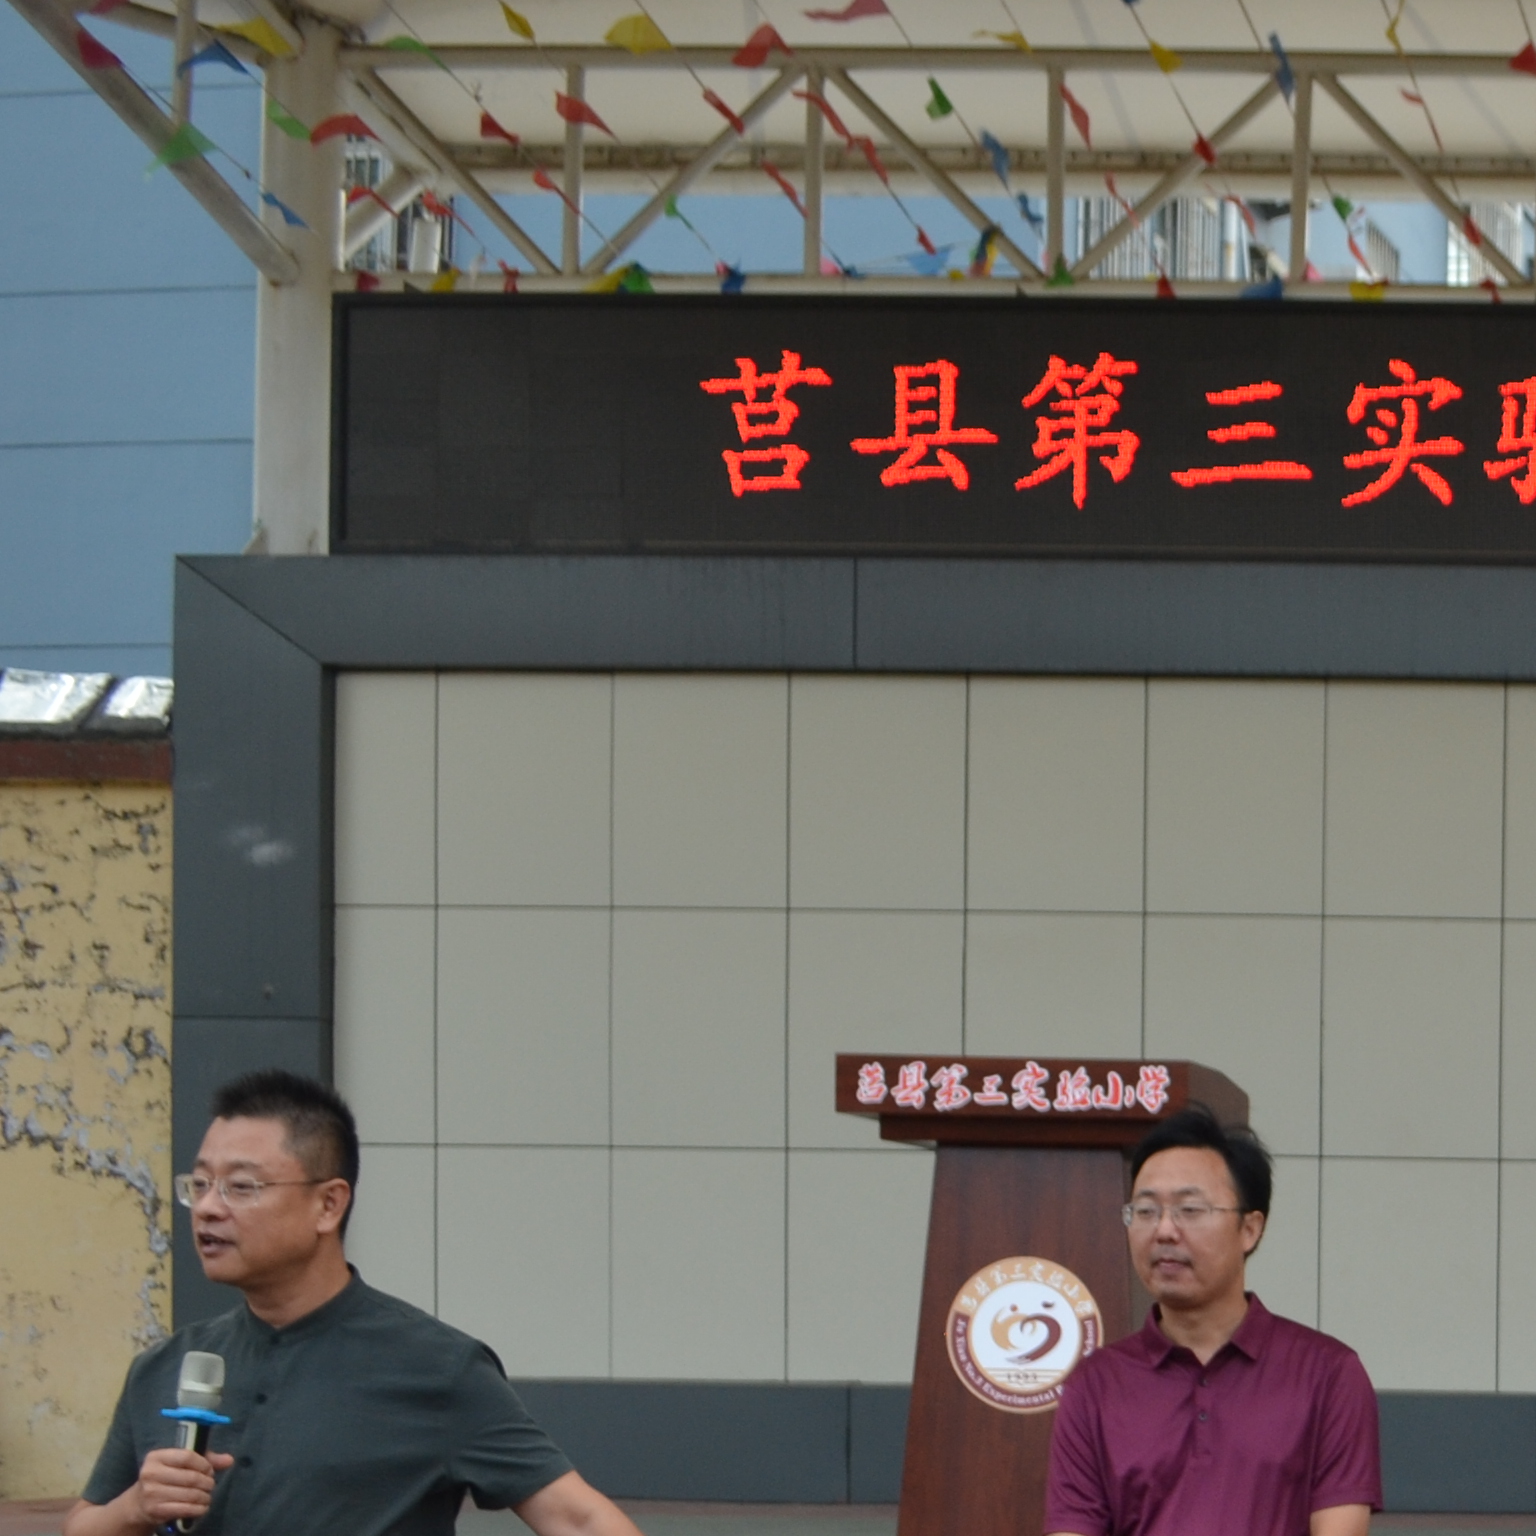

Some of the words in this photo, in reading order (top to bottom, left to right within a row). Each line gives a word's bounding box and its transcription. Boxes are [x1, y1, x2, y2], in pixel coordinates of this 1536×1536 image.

[856, 1060, 1170, 1113] 莒县第三实验小学
